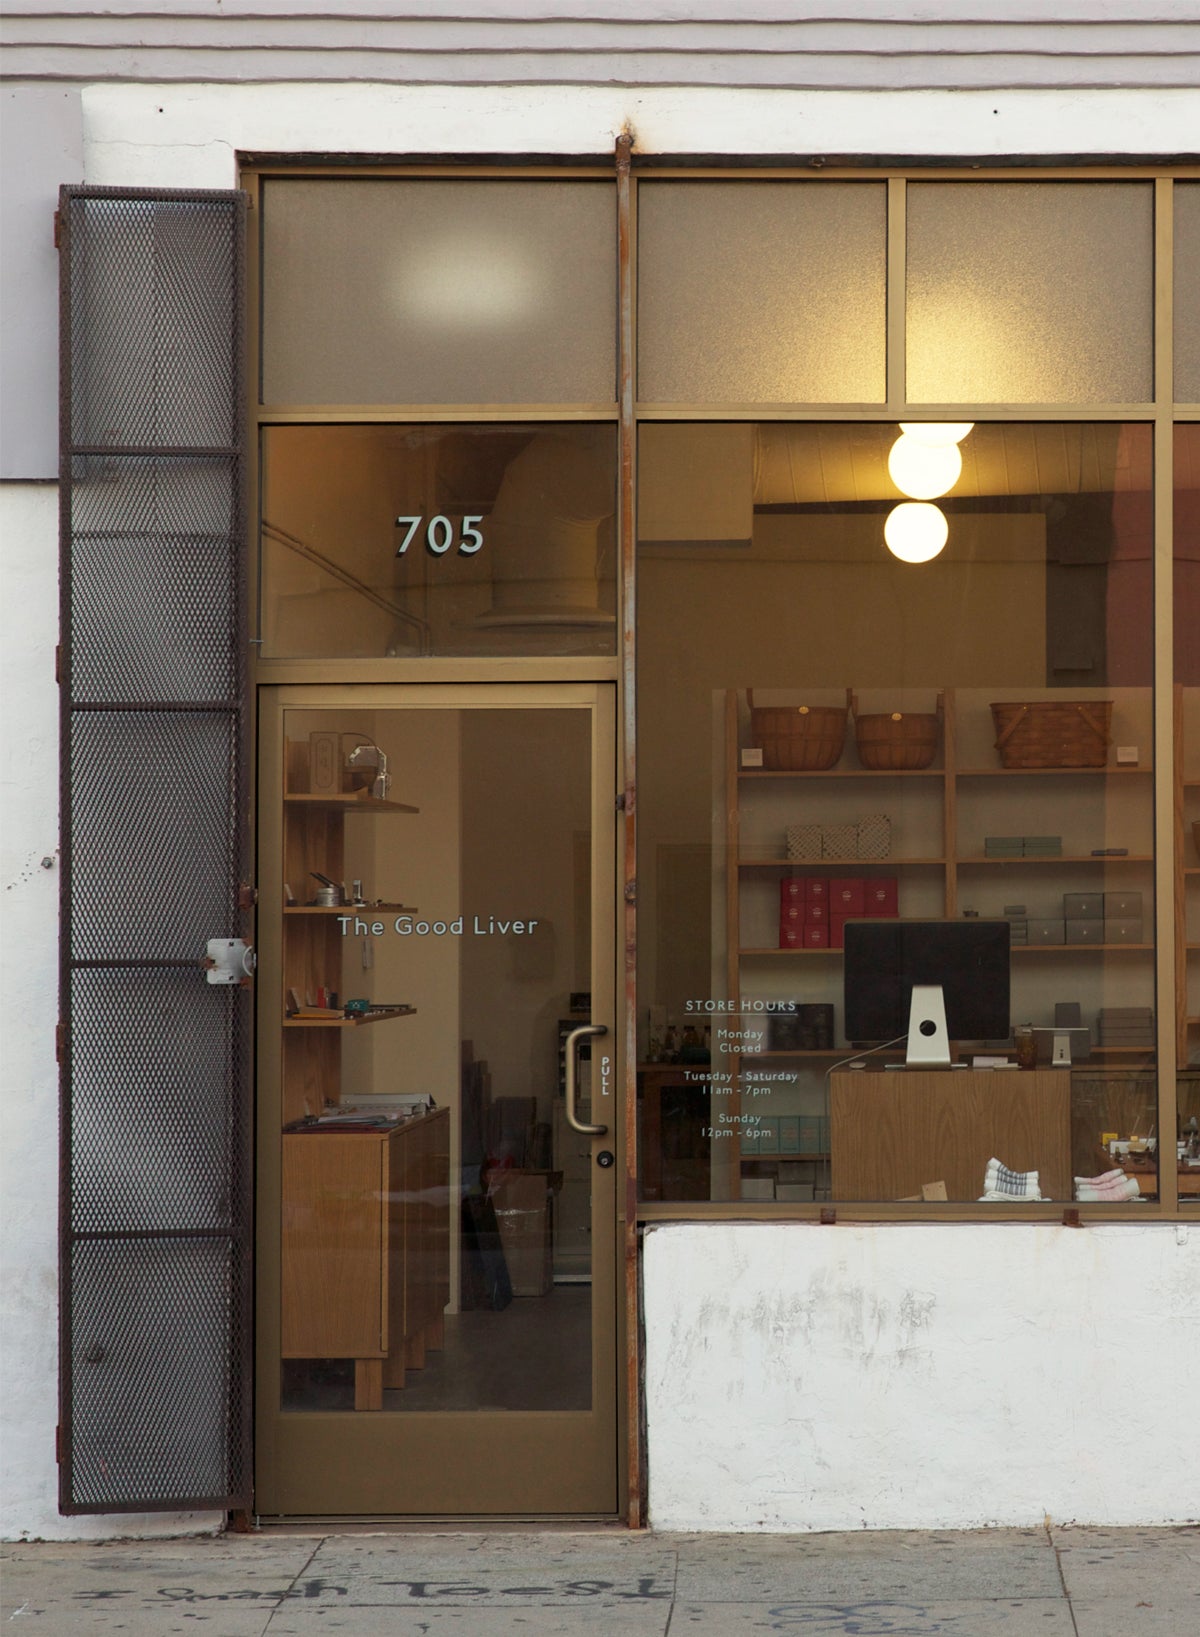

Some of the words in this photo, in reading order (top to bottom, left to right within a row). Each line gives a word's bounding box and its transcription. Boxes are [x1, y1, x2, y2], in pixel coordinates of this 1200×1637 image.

[397, 514, 484, 554] 705
[336, 916, 385, 936] The
[394, 915, 464, 936] Good
[473, 915, 538, 936] Liver
[685, 999, 736, 1011] STORE
[741, 999, 797, 1011] HOURS
[717, 1029, 764, 1041] Monday
[719, 1043, 762, 1054] Closed
[601, 1056, 611, 1096] PULL
[683, 1071, 733, 1083] Tuesday
[745, 1071, 798, 1083] Saturday
[702, 1085, 733, 1095] 11am
[745, 1085, 771, 1097] 7pm
[718, 1113, 762, 1125] Sunday
[701, 1128, 734, 1139] 12pm
[745, 1128, 772, 1139] 6pm
